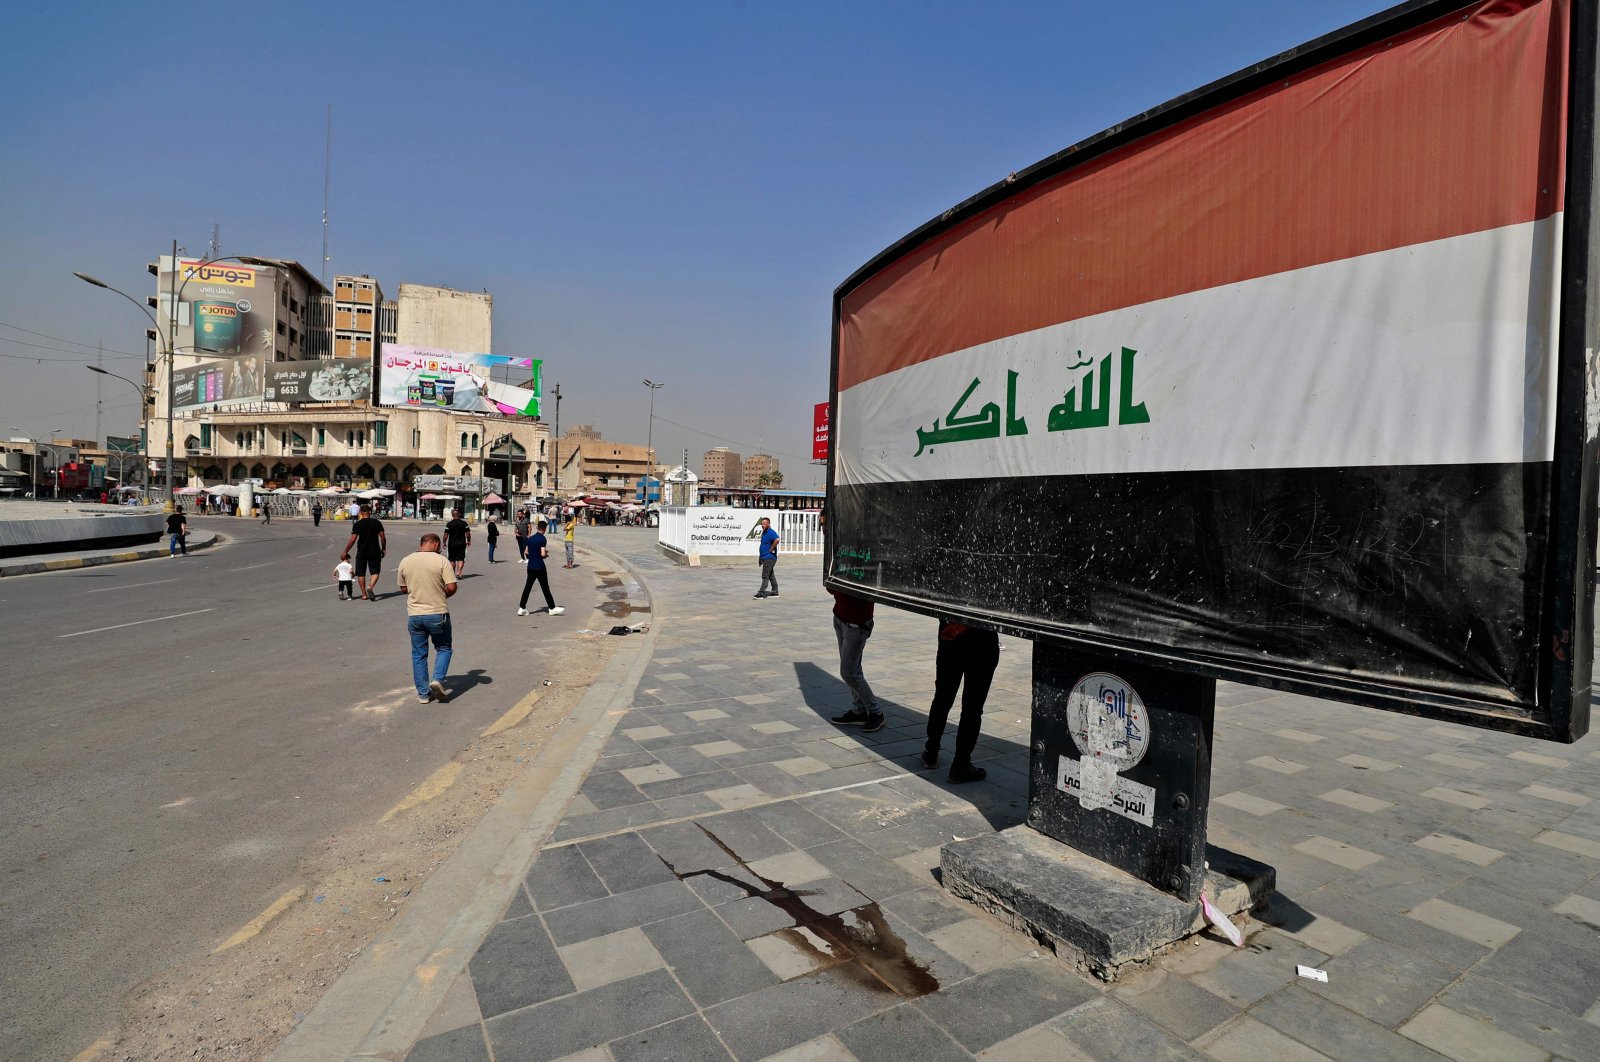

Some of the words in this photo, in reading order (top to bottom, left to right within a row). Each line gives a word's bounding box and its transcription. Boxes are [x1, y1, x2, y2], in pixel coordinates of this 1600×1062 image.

[199, 267, 251, 284] جوتن
[209, 307, 236, 316] JOTUN
[387, 356, 427, 371] المرجان
[175, 380, 195, 396] PRIME
[280, 386, 299, 395] 6633
[711, 534, 742, 542] Company
